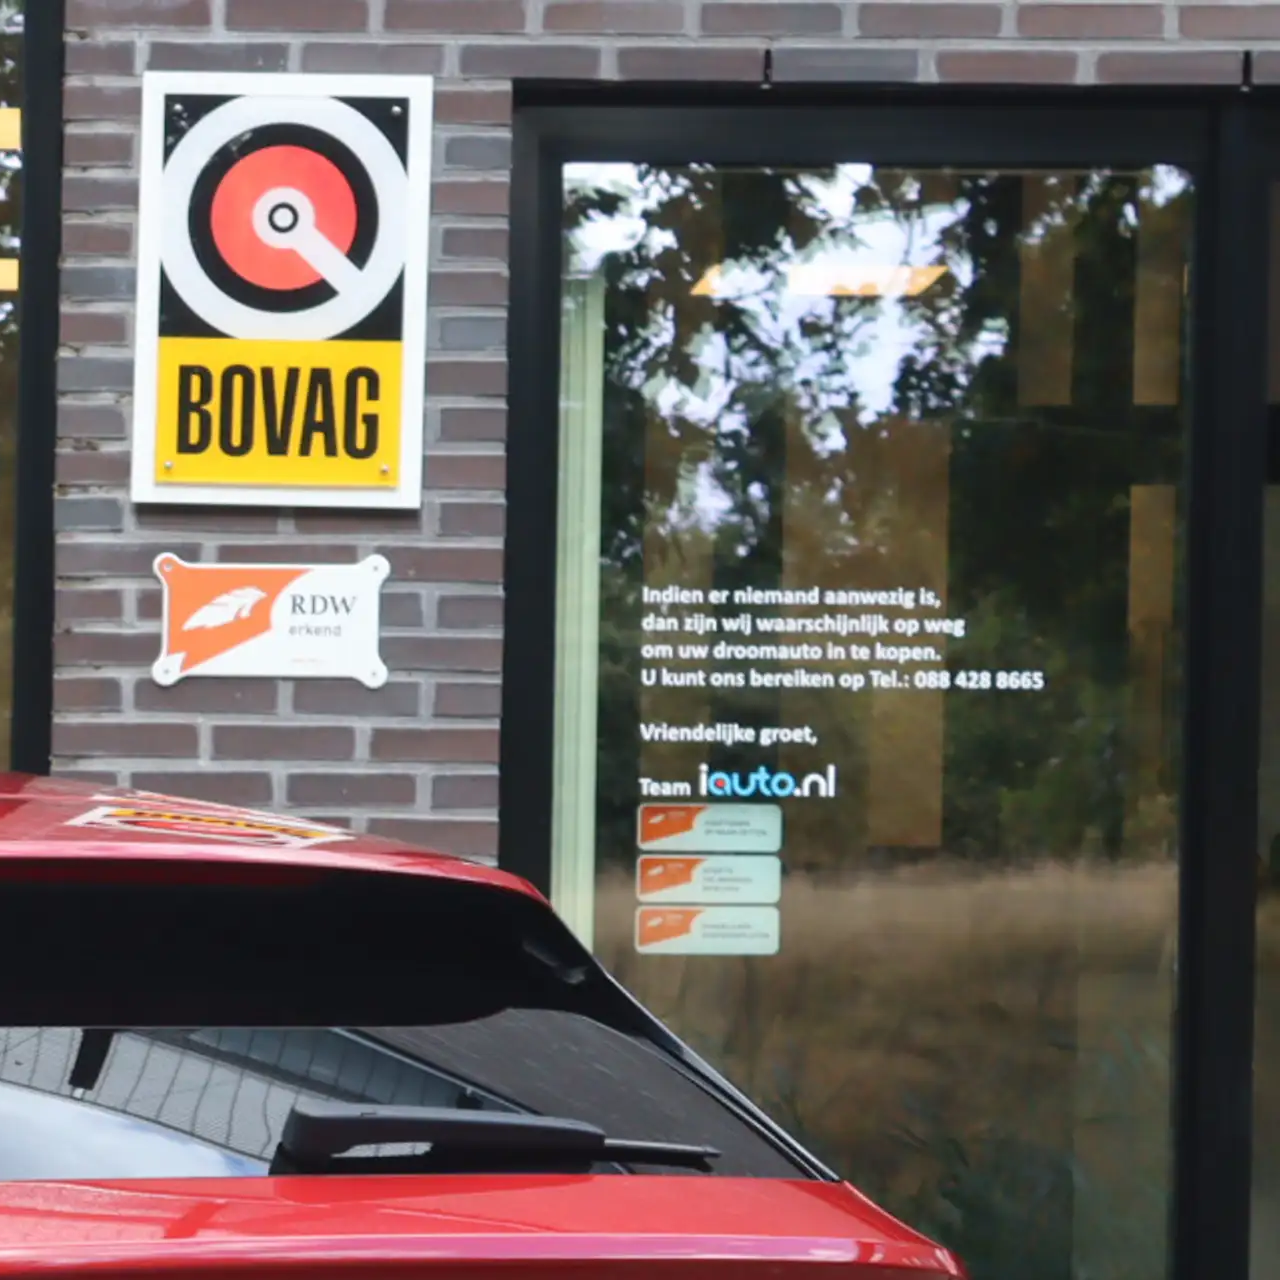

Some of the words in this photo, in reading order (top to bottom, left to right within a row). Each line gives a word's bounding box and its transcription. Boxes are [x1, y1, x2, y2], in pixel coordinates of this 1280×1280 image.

[177, 364, 380, 459] BOVAG
[289, 593, 358, 616] RDW
[642, 586, 703, 604] Indien
[708, 589, 729, 604] er
[733, 586, 820, 605] niemand
[824, 587, 915, 609] aanwezig
[919, 587, 942, 608] is,
[288, 623, 342, 637] erkend
[641, 613, 679, 631] dan
[684, 614, 717, 635] zijn
[721, 613, 752, 635] wij
[756, 614, 889, 637] waarschijnlijk
[893, 618, 919, 636] op
[924, 618, 965, 637] weg
[641, 644, 673, 659] om
[678, 644, 709, 659] uw
[713, 641, 822, 660] droomauto
[827, 642, 845, 660] in
[850, 644, 870, 660] te
[875, 642, 942, 664] kopen.
[641, 668, 656, 686] U
[661, 667, 706, 687] kunt
[710, 672, 745, 687] ons
[749, 668, 835, 687] bereiken
[840, 673, 865, 691] op
[869, 670, 910, 688] Tel.:
[914, 671, 951, 689] 088
[955, 671, 991, 689] 428
[996, 671, 1044, 690] 8665
[640, 723, 756, 746] Vriendelijke
[759, 725, 818, 746] groet,
[638, 778, 691, 796] Team
[699, 762, 836, 797] iauto.nl
